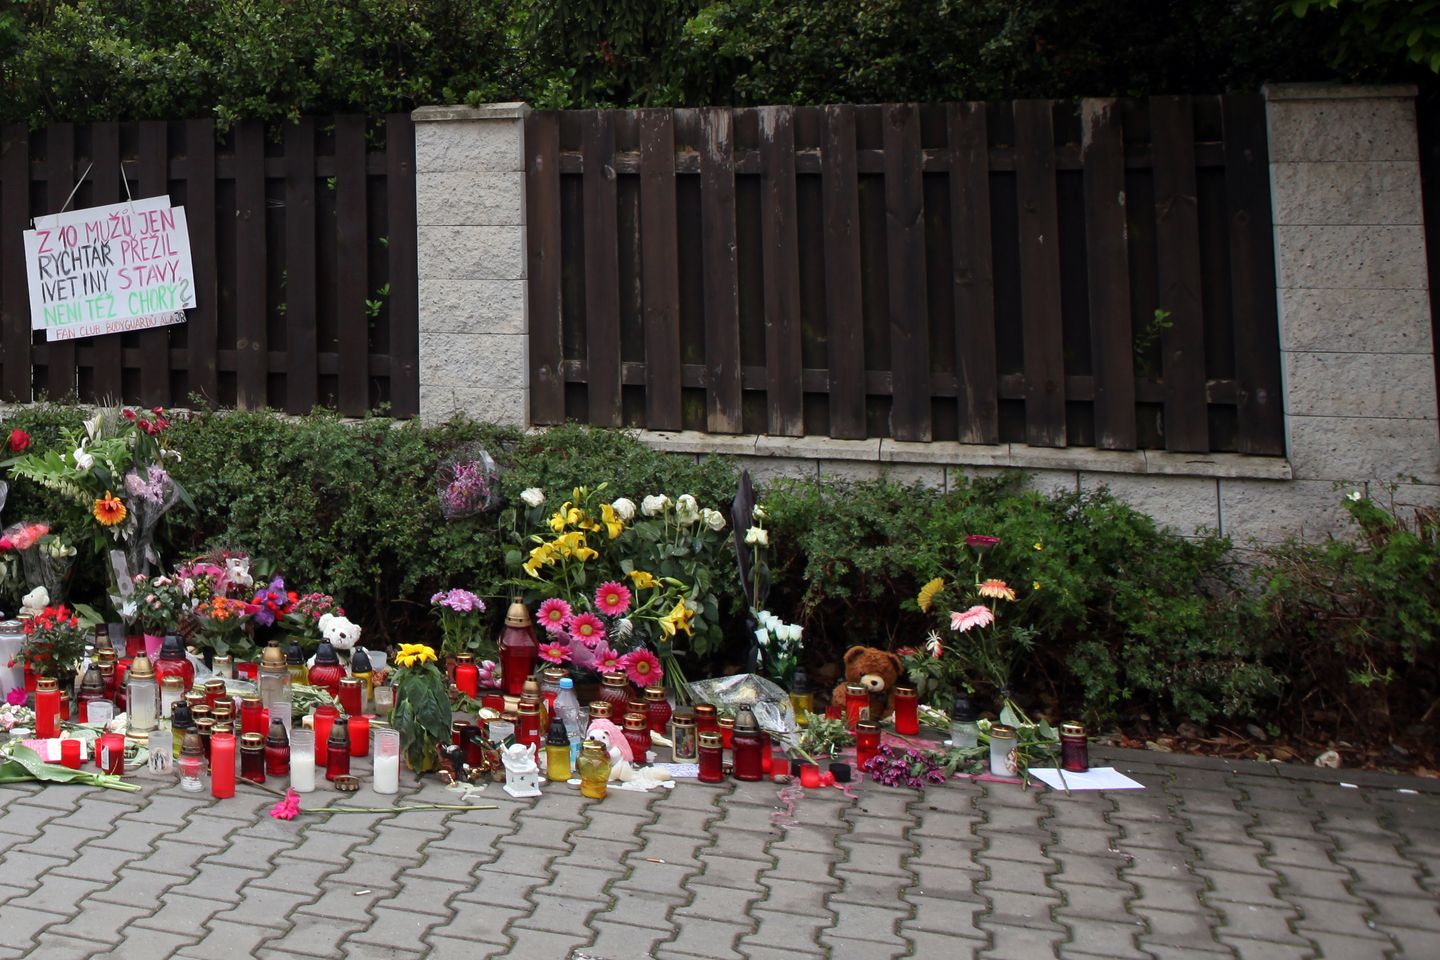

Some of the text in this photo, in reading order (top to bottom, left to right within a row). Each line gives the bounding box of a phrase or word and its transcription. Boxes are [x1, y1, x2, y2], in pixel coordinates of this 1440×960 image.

[36, 208, 176, 255] Z 10 MUŽŮ JEN
[38, 233, 178, 281] RYCHTÁŘ PŘEŽIL
[43, 292, 83, 327] NENÍ
[85, 291, 118, 320] TÉŽ
[56, 328, 76, 340] FAN
[80, 323, 101, 336] CLUB
